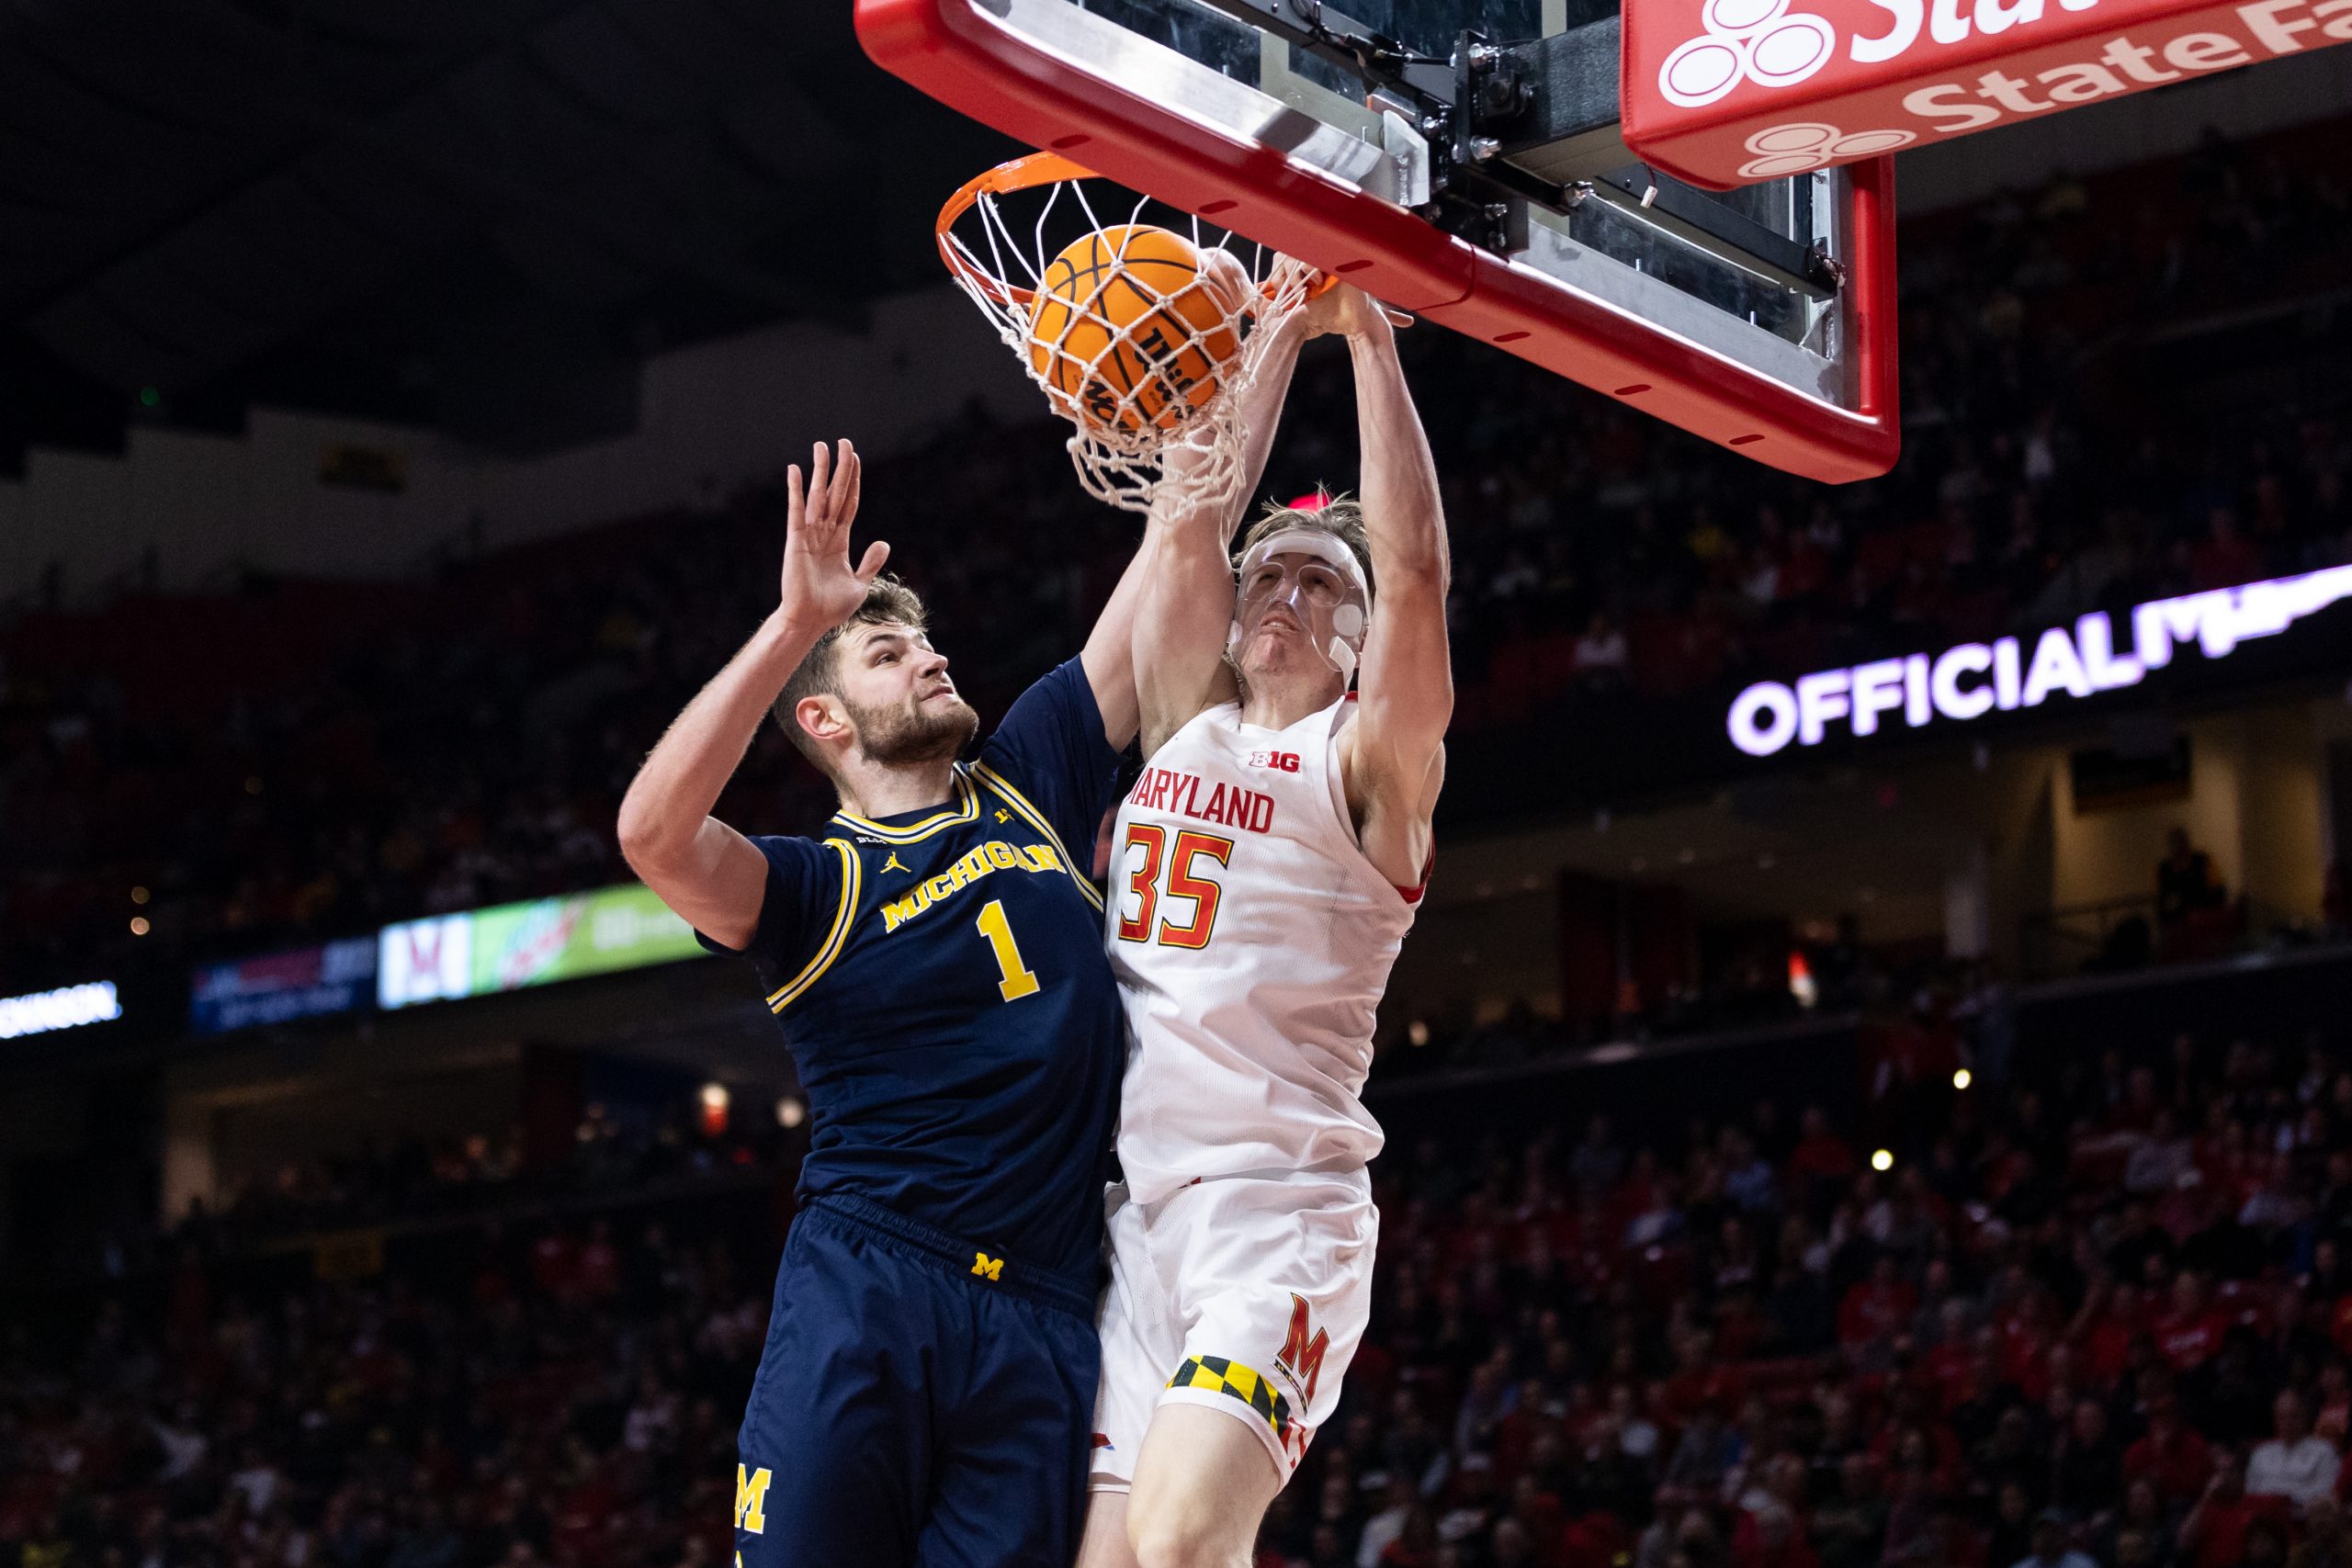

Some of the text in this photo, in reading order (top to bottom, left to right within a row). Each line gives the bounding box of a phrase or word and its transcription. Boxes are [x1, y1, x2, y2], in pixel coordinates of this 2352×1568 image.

[1902, 32, 2253, 132] State
[1727, 612, 2144, 756] OFFICIAL
[879, 841, 1067, 933] MICHIGAN
[1118, 822, 1235, 950] 35
[976, 899, 1040, 1003] 1
[971, 1252, 1004, 1281] M
[1278, 1292, 1330, 1406] M
[734, 1462, 772, 1535] M
